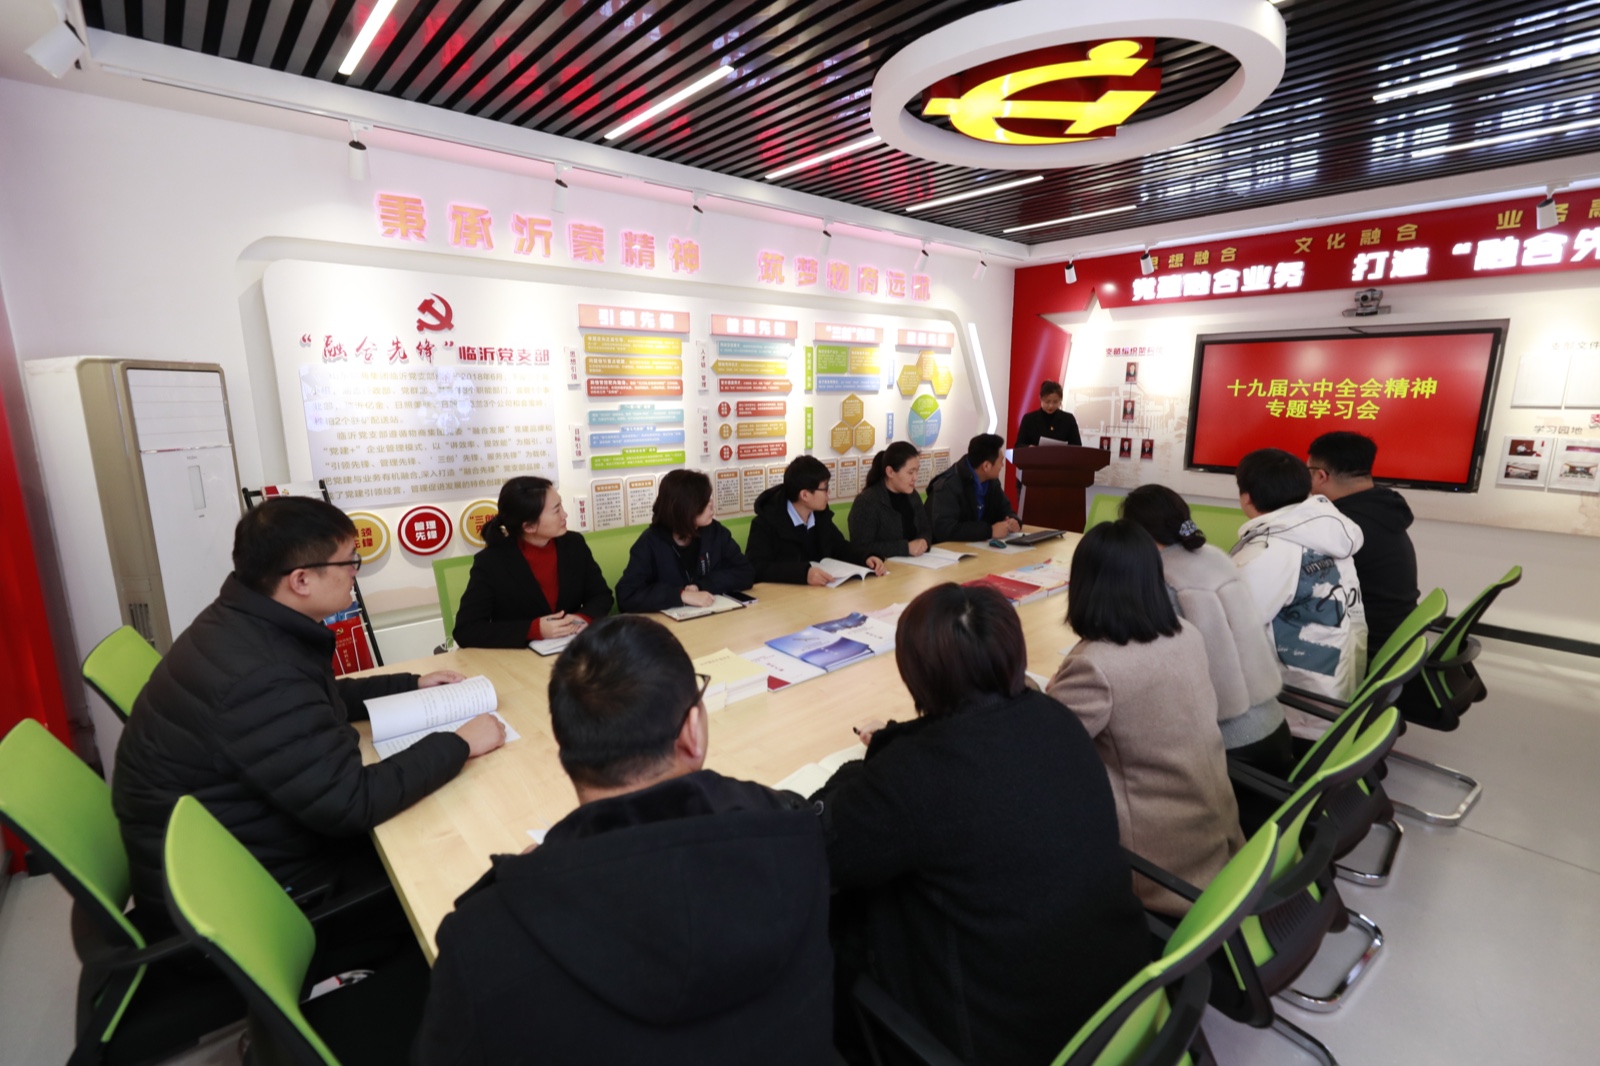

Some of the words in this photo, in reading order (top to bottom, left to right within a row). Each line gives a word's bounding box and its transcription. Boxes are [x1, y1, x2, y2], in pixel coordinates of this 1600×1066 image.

[377, 192, 701, 274] 秉承沂蒙精神
[1294, 223, 1418, 254] 文化融合
[1131, 261, 1305, 301] 党建融合业务
[1351, 247, 1429, 281] 打造
[1227, 377, 1437, 400] 十九届六中全会精神
[1265, 399, 1380, 421] 专题学习会
[1534, 425, 1583, 435] 学习园地
[579, 500, 587, 528] 智慧引领
[355, 527, 371, 538] 领
[413, 520, 437, 531] 管理
[415, 530, 438, 542] 先锋
